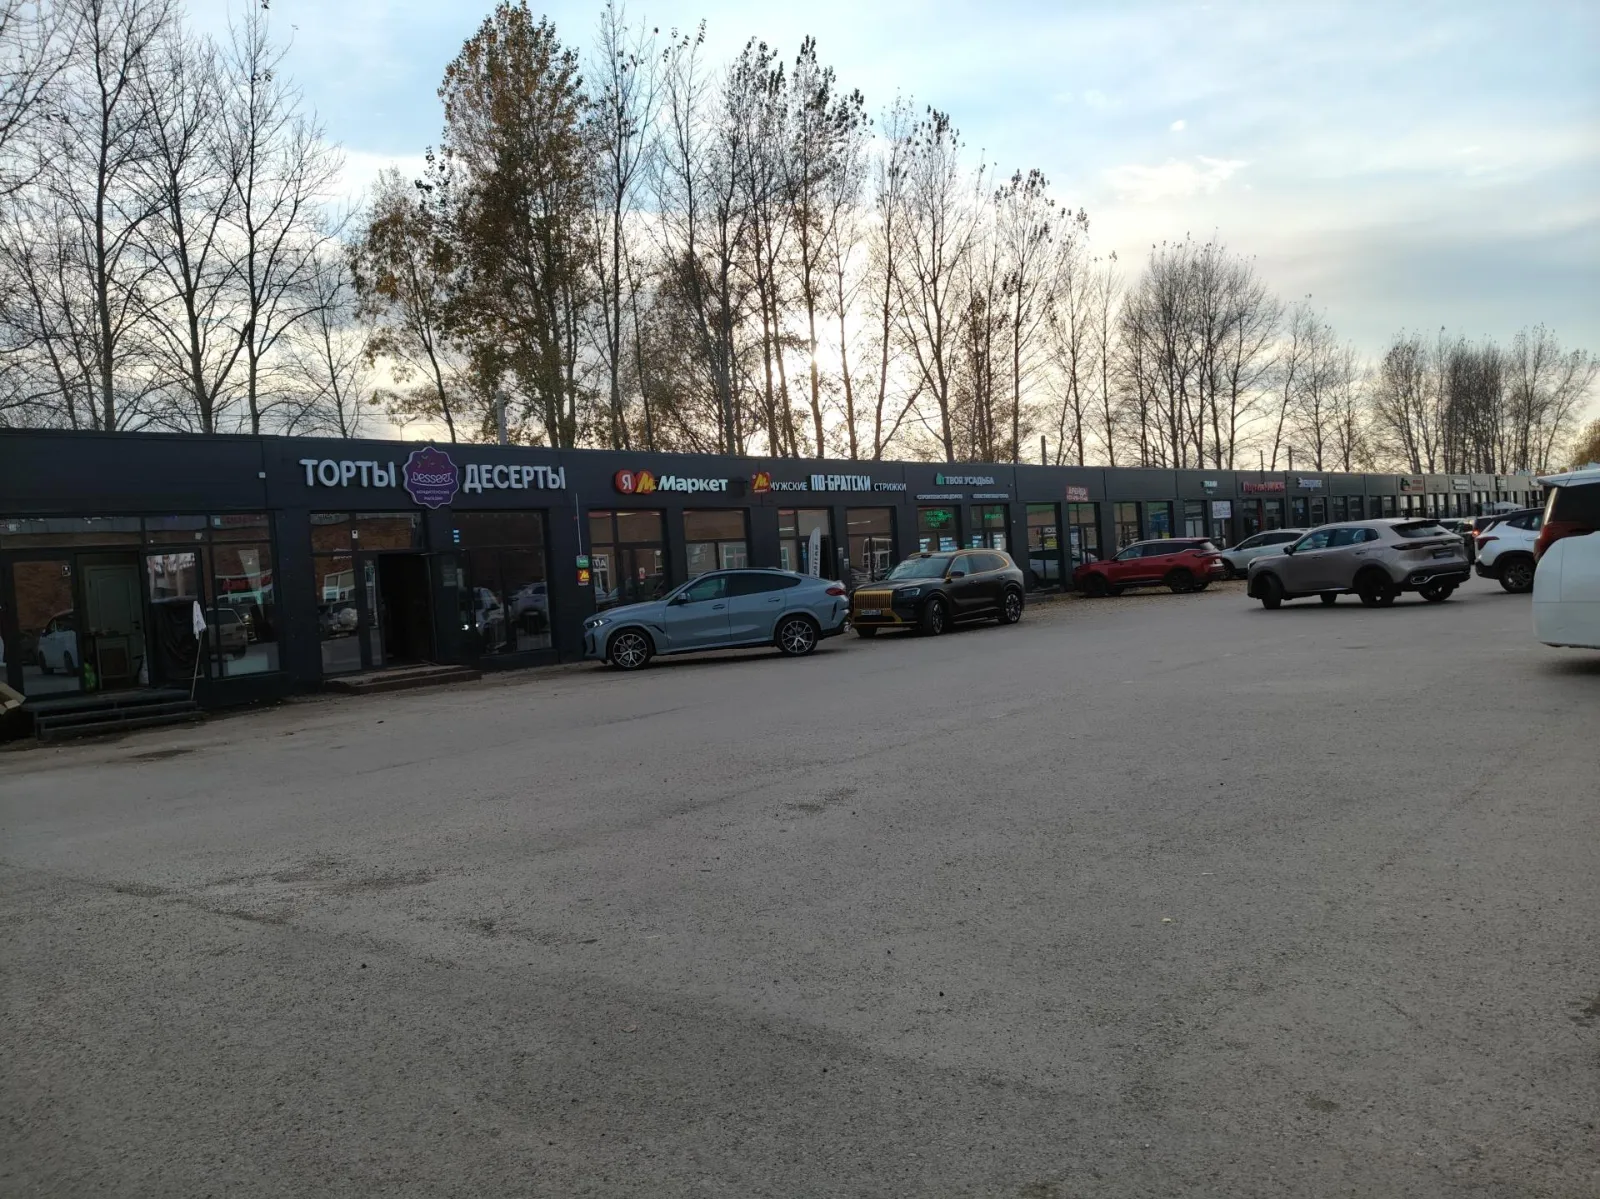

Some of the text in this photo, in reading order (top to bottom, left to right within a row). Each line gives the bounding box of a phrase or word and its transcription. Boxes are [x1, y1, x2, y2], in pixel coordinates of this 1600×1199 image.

[299, 459, 396, 488] ТОРТЫ
[463, 464, 566, 494] ДЕСЕРТЫ
[811, 474, 871, 492] ПО-БРАТСКИ
[874, 482, 907, 492] СТРИЖКИ
[945, 476, 995, 487] ТВОЯ УСАДЬБА
[658, 475, 728, 494] Маркет
